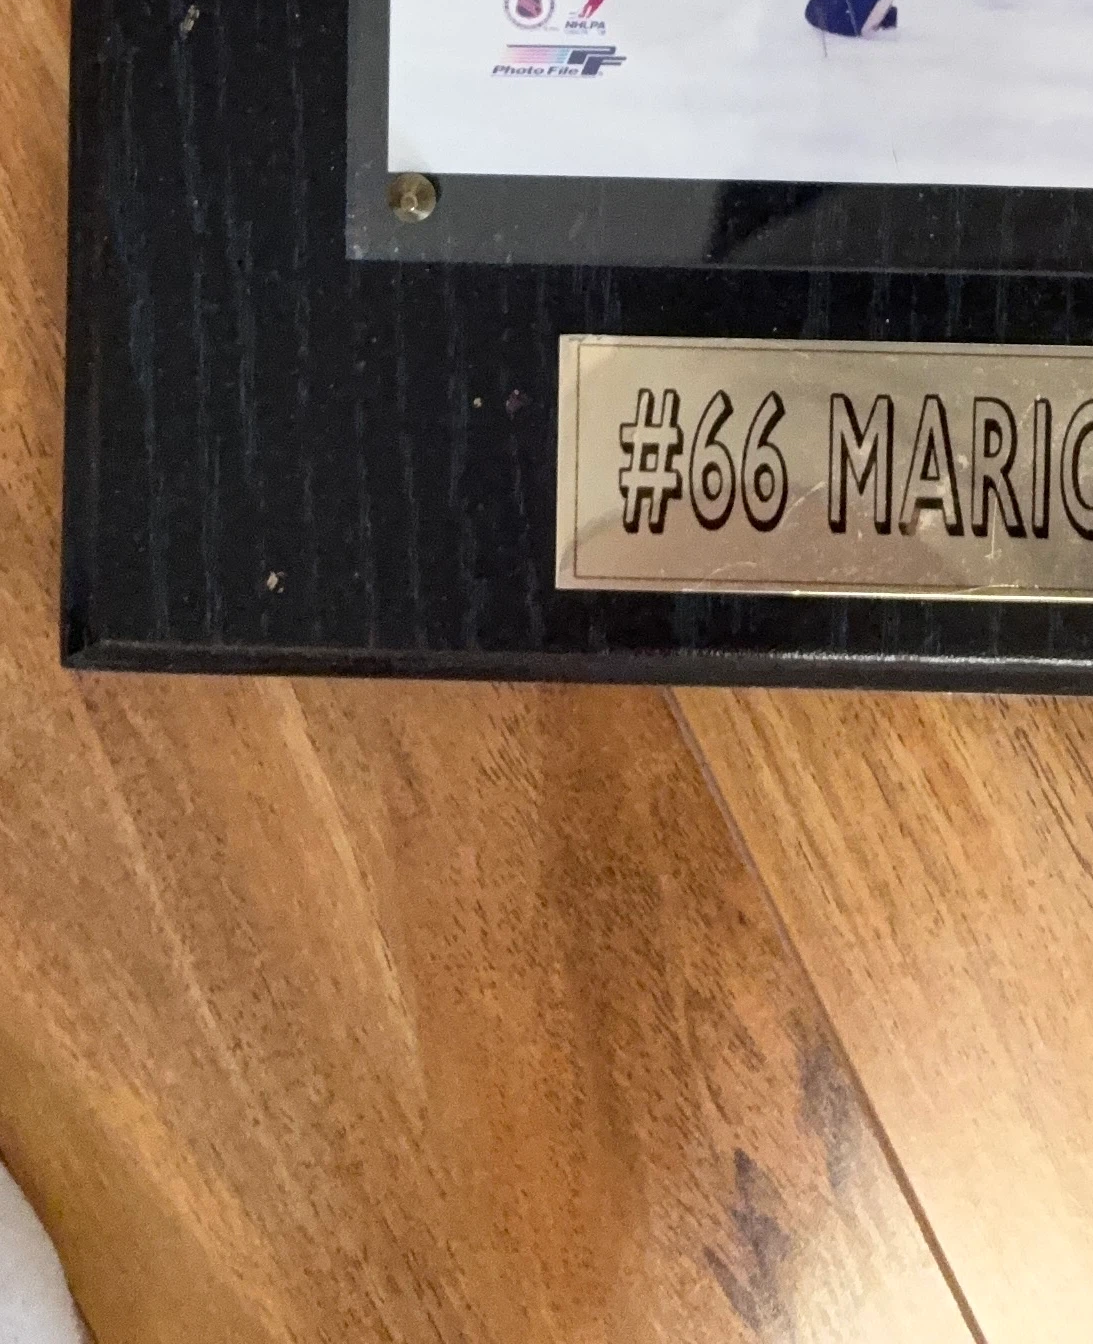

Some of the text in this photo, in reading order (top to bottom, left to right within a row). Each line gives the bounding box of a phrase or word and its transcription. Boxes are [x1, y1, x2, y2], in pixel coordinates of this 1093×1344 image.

[564, 20, 606, 30] NHLPA
[492, 64, 580, 76] Photo File
[618, 387, 789, 535] #66
